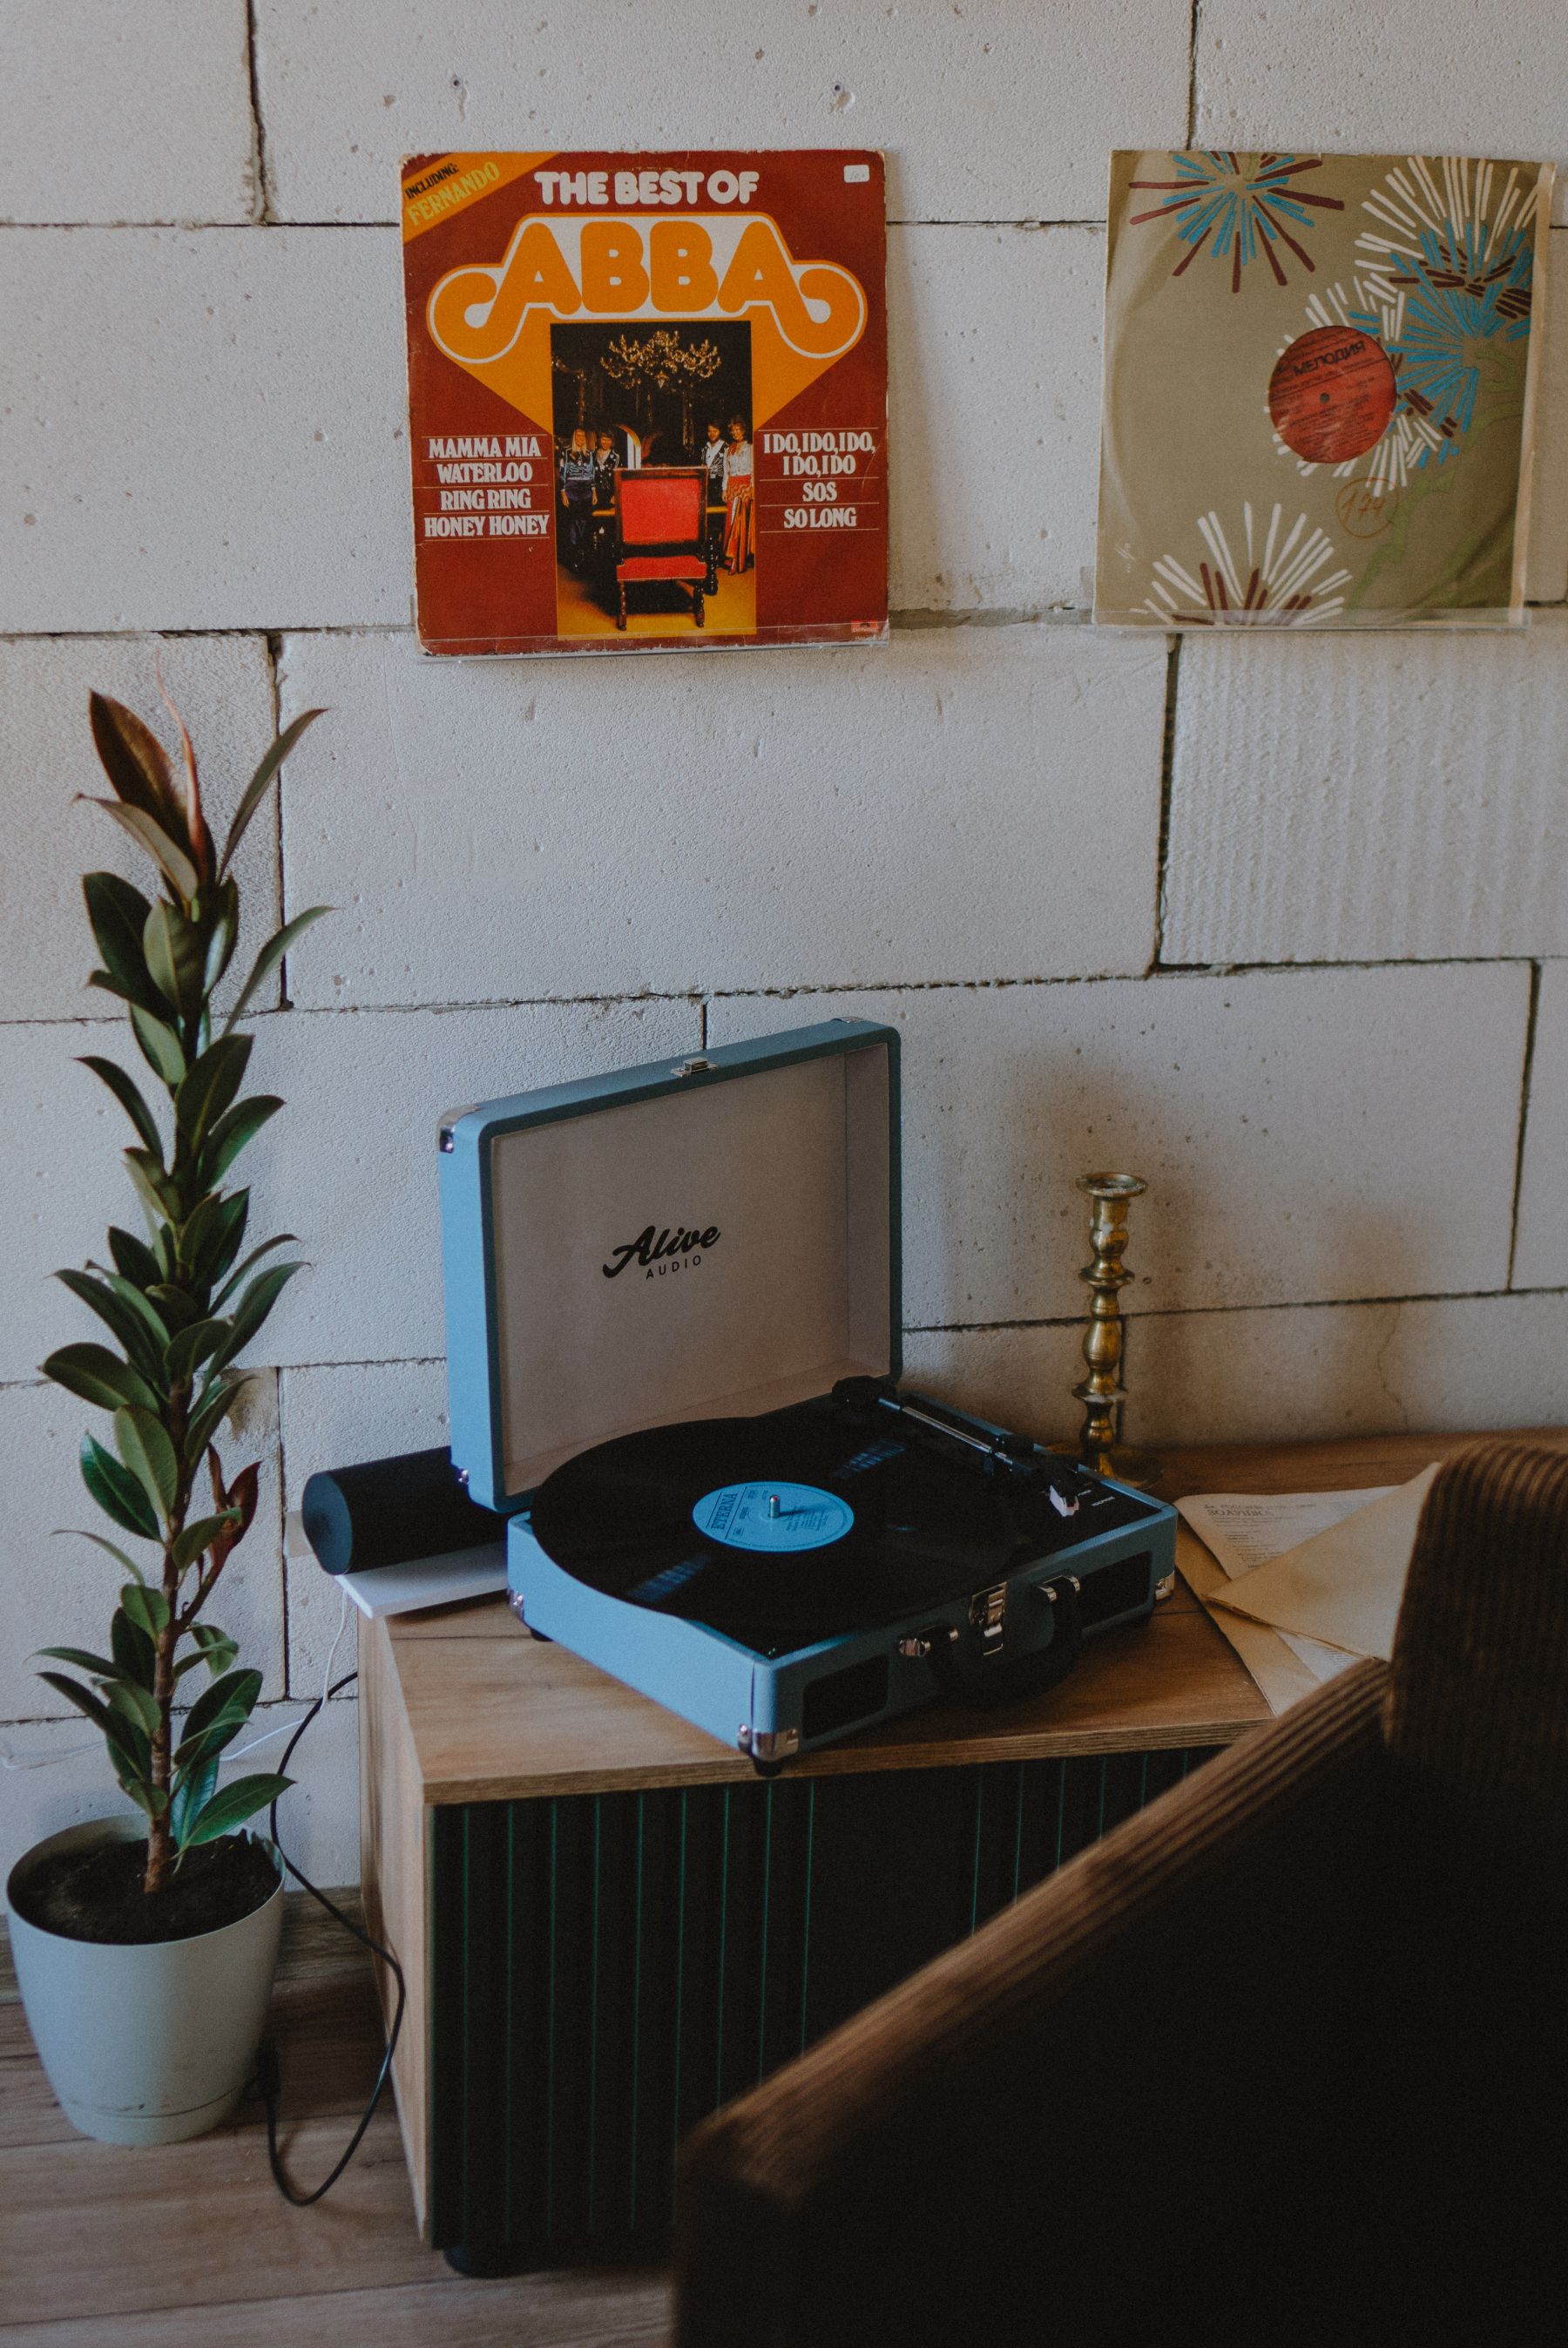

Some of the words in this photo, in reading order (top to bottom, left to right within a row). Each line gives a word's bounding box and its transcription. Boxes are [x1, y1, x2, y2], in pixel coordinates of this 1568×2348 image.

[405, 163, 459, 200] INCLUDING:
[406, 161, 500, 226] FERNANDO
[533, 171, 609, 205] THE
[614, 170, 705, 206] BEST
[706, 170, 760, 205] OF
[436, 220, 860, 358] ABBA
[1294, 340, 1367, 376] МЕЛОДИЯ
[429, 437, 503, 458] MAMMA
[505, 436, 541, 457] MIA
[436, 462, 533, 484] WATERLOO
[440, 490, 485, 511] RING
[487, 489, 531, 509] RING
[802, 482, 837, 502] SOS
[424, 517, 485, 537] HONEY
[489, 515, 550, 536] HONEY
[784, 508, 808, 528] SO
[809, 507, 857, 527] LONG
[602, 1226, 721, 1278] Alive
[646, 1255, 701, 1280] AUDIO
[710, 1492, 739, 1530] ETERNA
